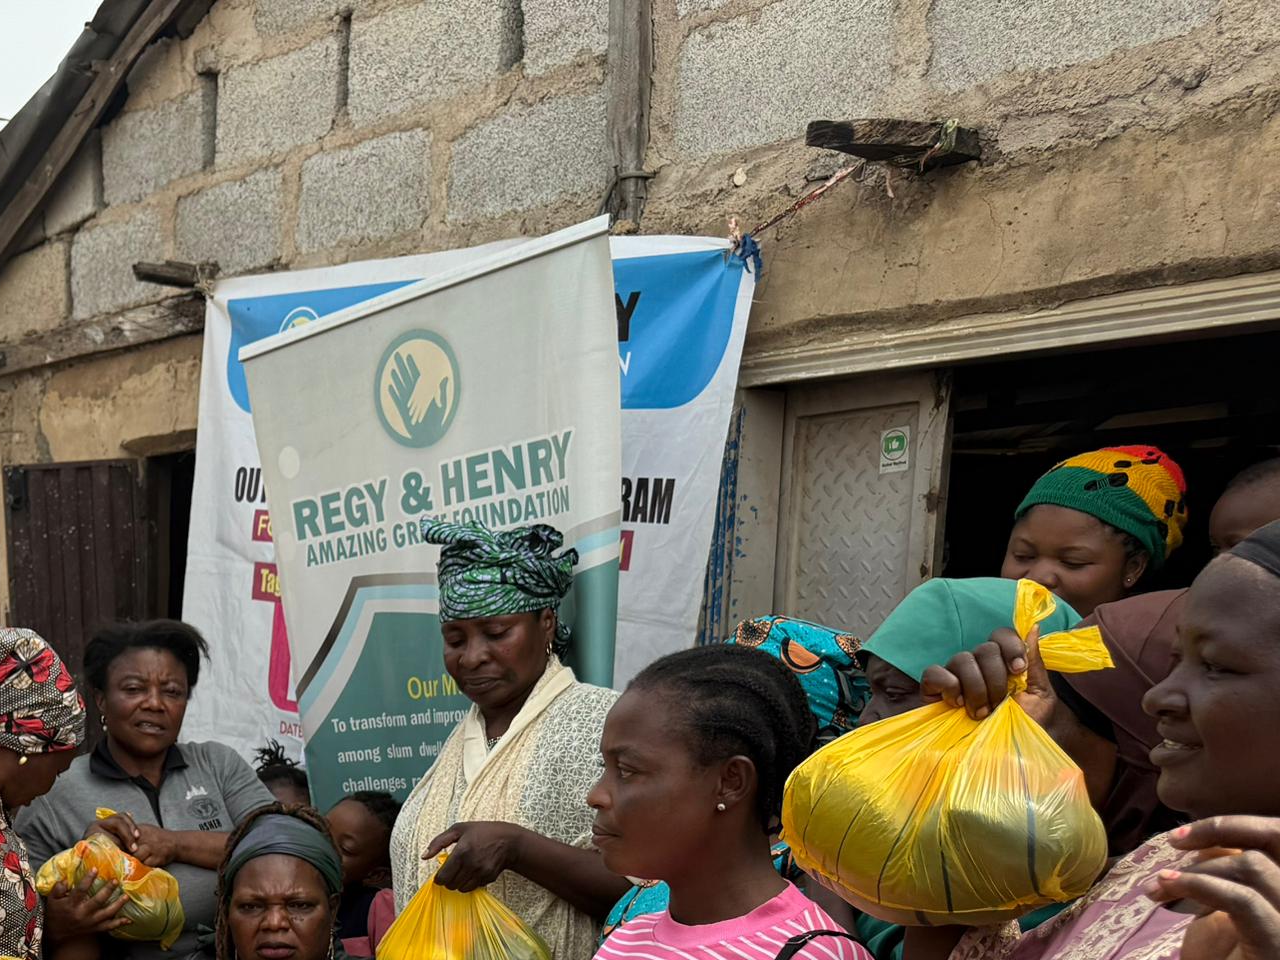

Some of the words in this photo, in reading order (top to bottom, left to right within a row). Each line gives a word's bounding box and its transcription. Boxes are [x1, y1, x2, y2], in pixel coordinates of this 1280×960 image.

[293, 479, 387, 541] REGY
[401, 471, 433, 515] &
[440, 431, 572, 506] HENRY
[307, 528, 387, 567] AMAZING
[407, 676, 438, 700] Our
[331, 719, 347, 733] To
[350, 713, 407, 731] transform
[410, 709, 431, 726] and
[338, 746, 381, 764] among
[387, 743, 412, 759] slum
[342, 777, 407, 793] challenges
